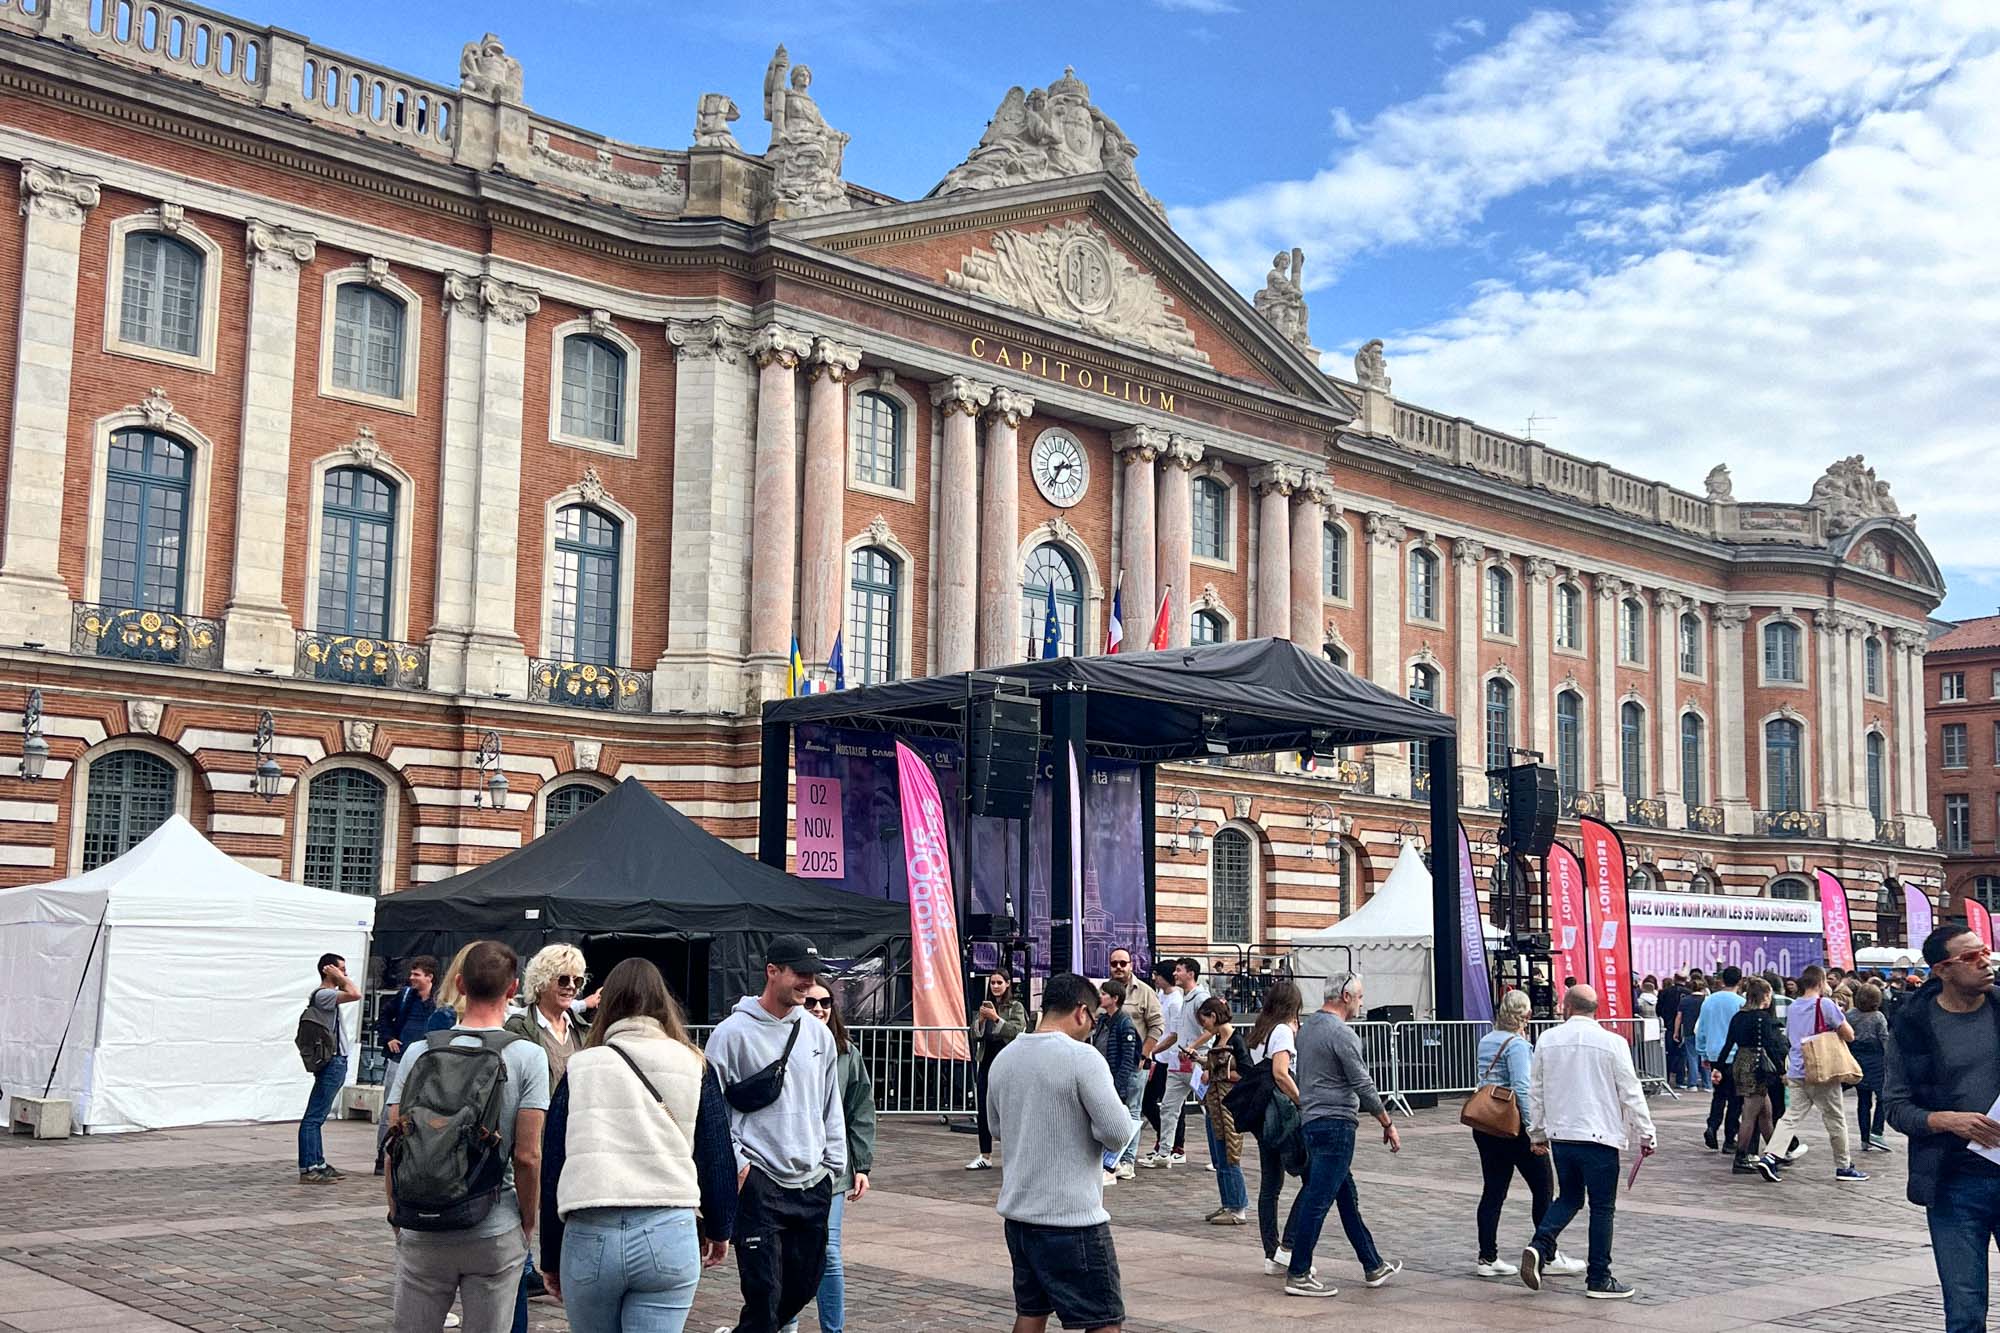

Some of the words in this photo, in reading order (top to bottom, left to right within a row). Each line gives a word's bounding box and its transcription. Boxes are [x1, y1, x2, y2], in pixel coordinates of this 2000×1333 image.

[971, 337, 1175, 413] CAPITOLIUM
[810, 784, 827, 805] 02
[804, 818, 834, 838] NOV.
[802, 851, 838, 872] 2025
[1654, 902, 1680, 917] VOTRE
[1681, 903, 1700, 918] NOM
[1729, 905, 1742, 920] LES
